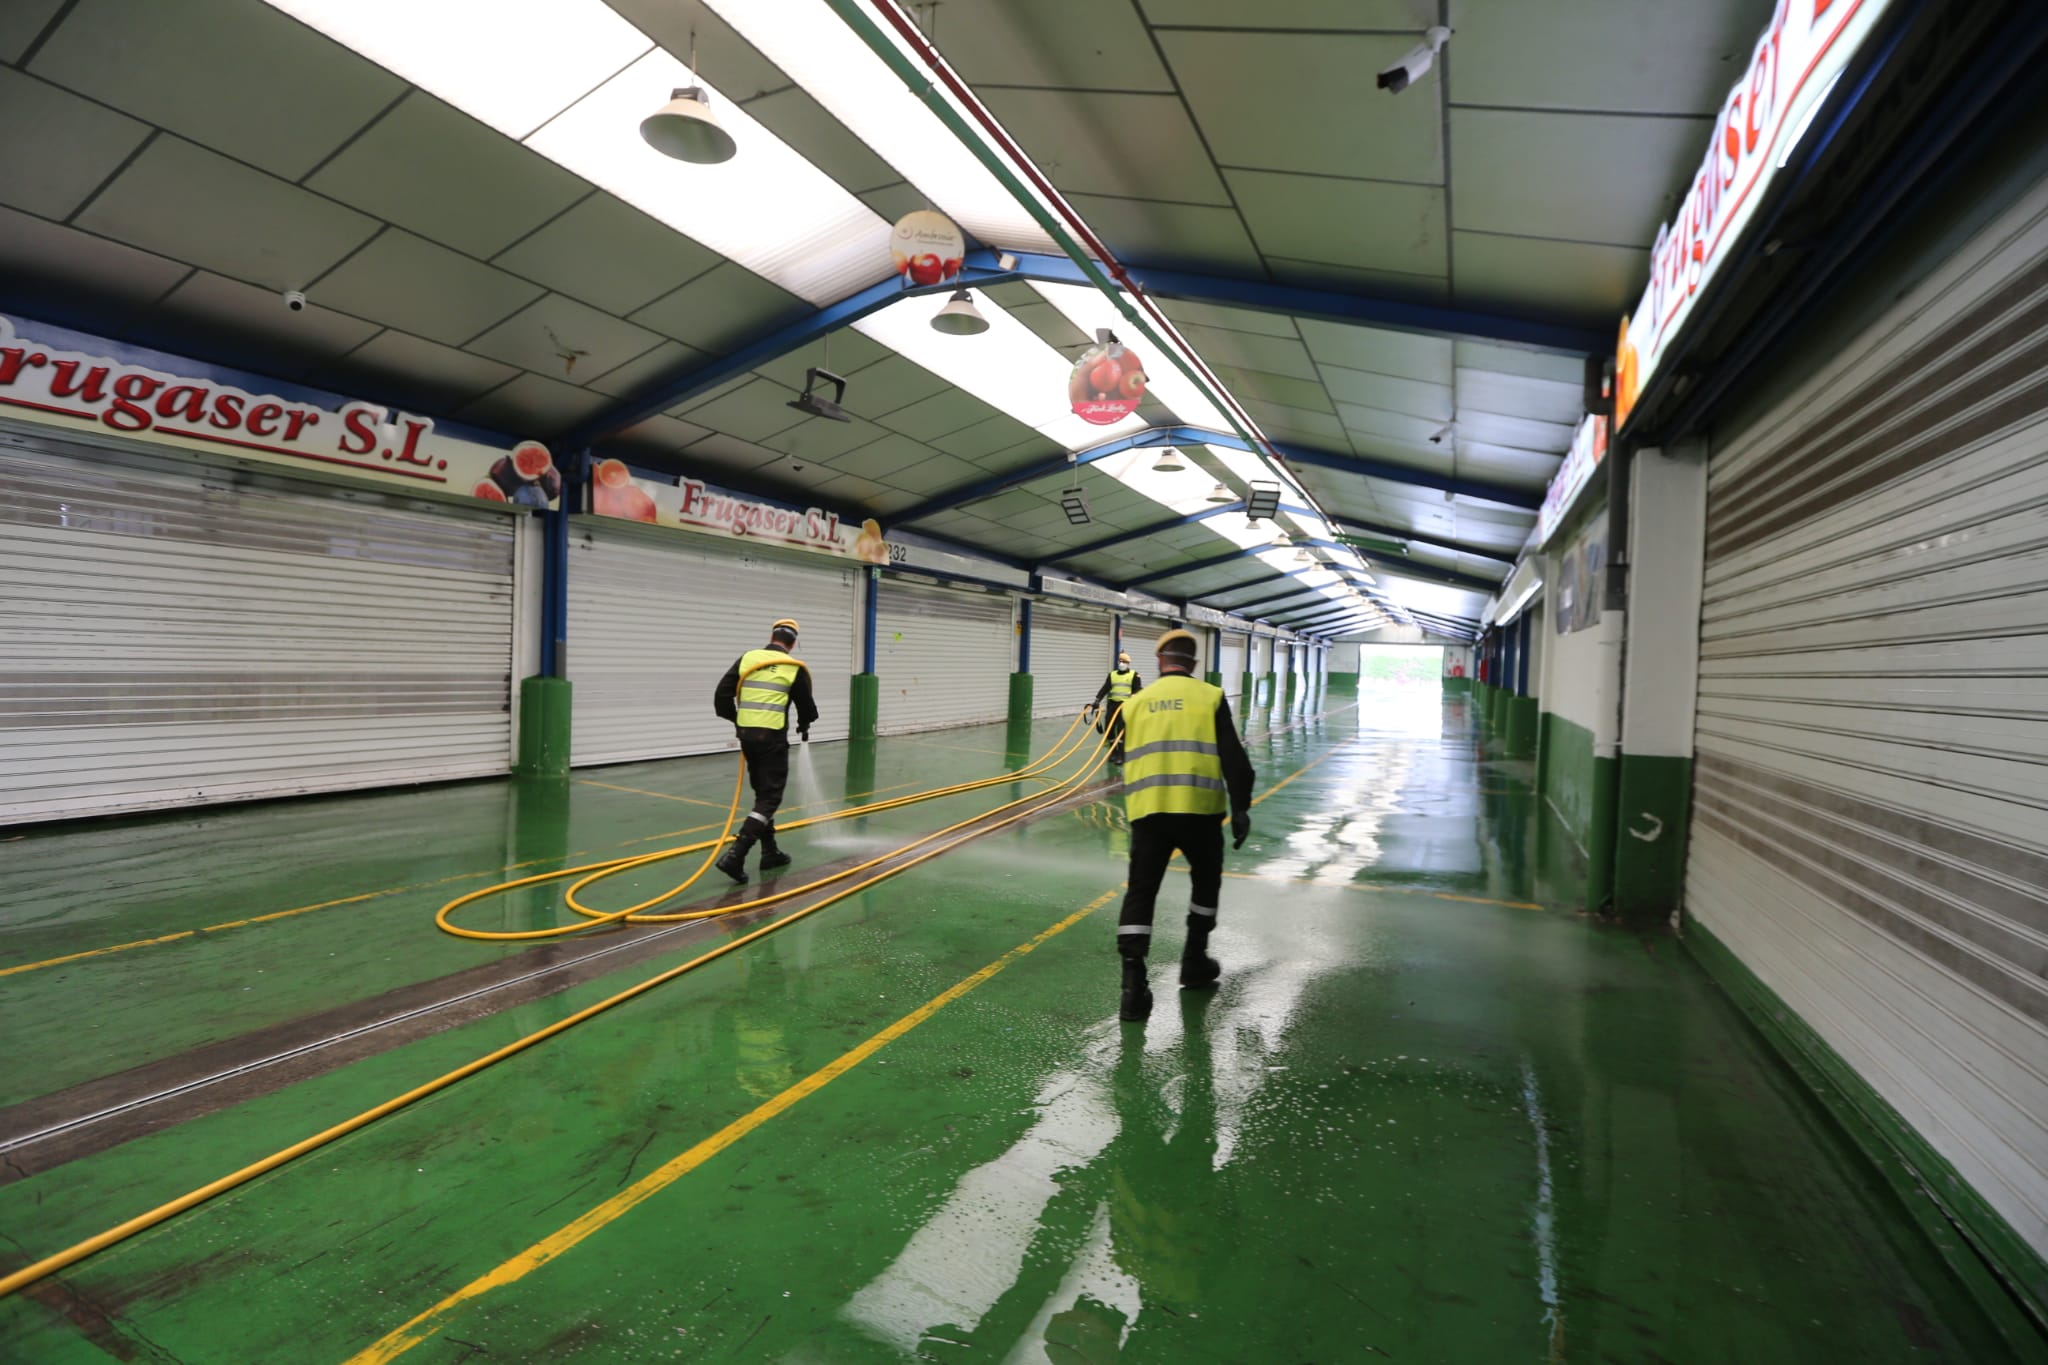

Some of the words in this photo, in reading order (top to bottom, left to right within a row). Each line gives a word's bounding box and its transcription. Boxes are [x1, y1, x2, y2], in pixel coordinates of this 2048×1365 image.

[0, 346, 320, 441] rugaser
[338, 407, 448, 470] S.L.
[680, 482, 801, 536] Frugaser
[806, 511, 846, 545] S.L.
[1149, 699, 1183, 713] UME
